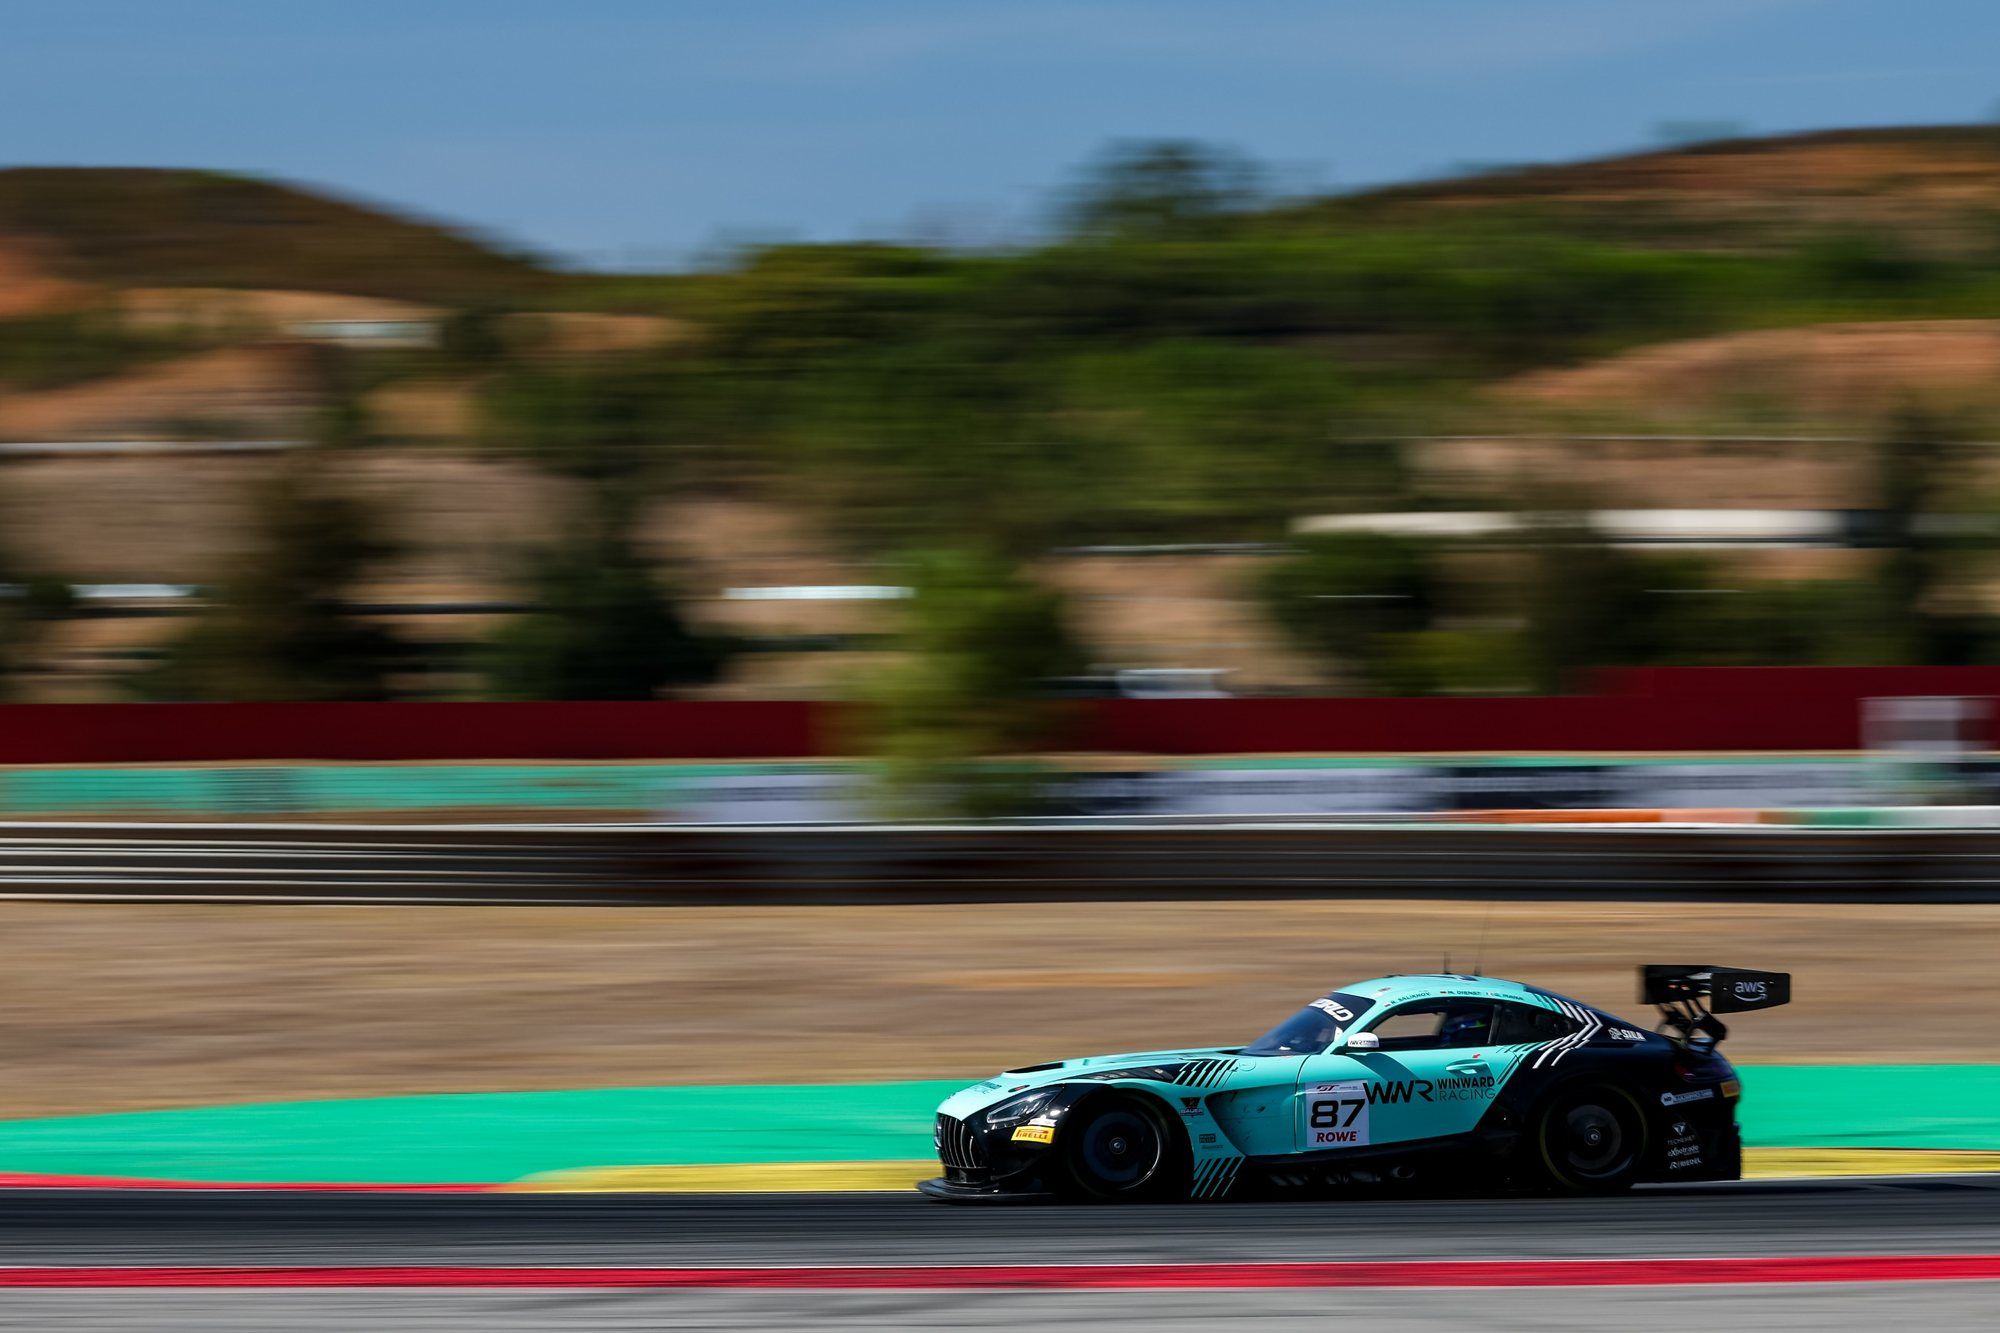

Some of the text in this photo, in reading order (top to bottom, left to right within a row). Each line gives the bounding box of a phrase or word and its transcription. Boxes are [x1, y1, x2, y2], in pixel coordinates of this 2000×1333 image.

[1734, 981, 1767, 993] aws
[1437, 1076, 1495, 1089] WINWARD
[1439, 1088, 1496, 1101] RACING
[1310, 1098, 1366, 1129] 87
[1015, 1129, 1049, 1140] PIRELLI
[1316, 1130, 1357, 1143] ROWE
